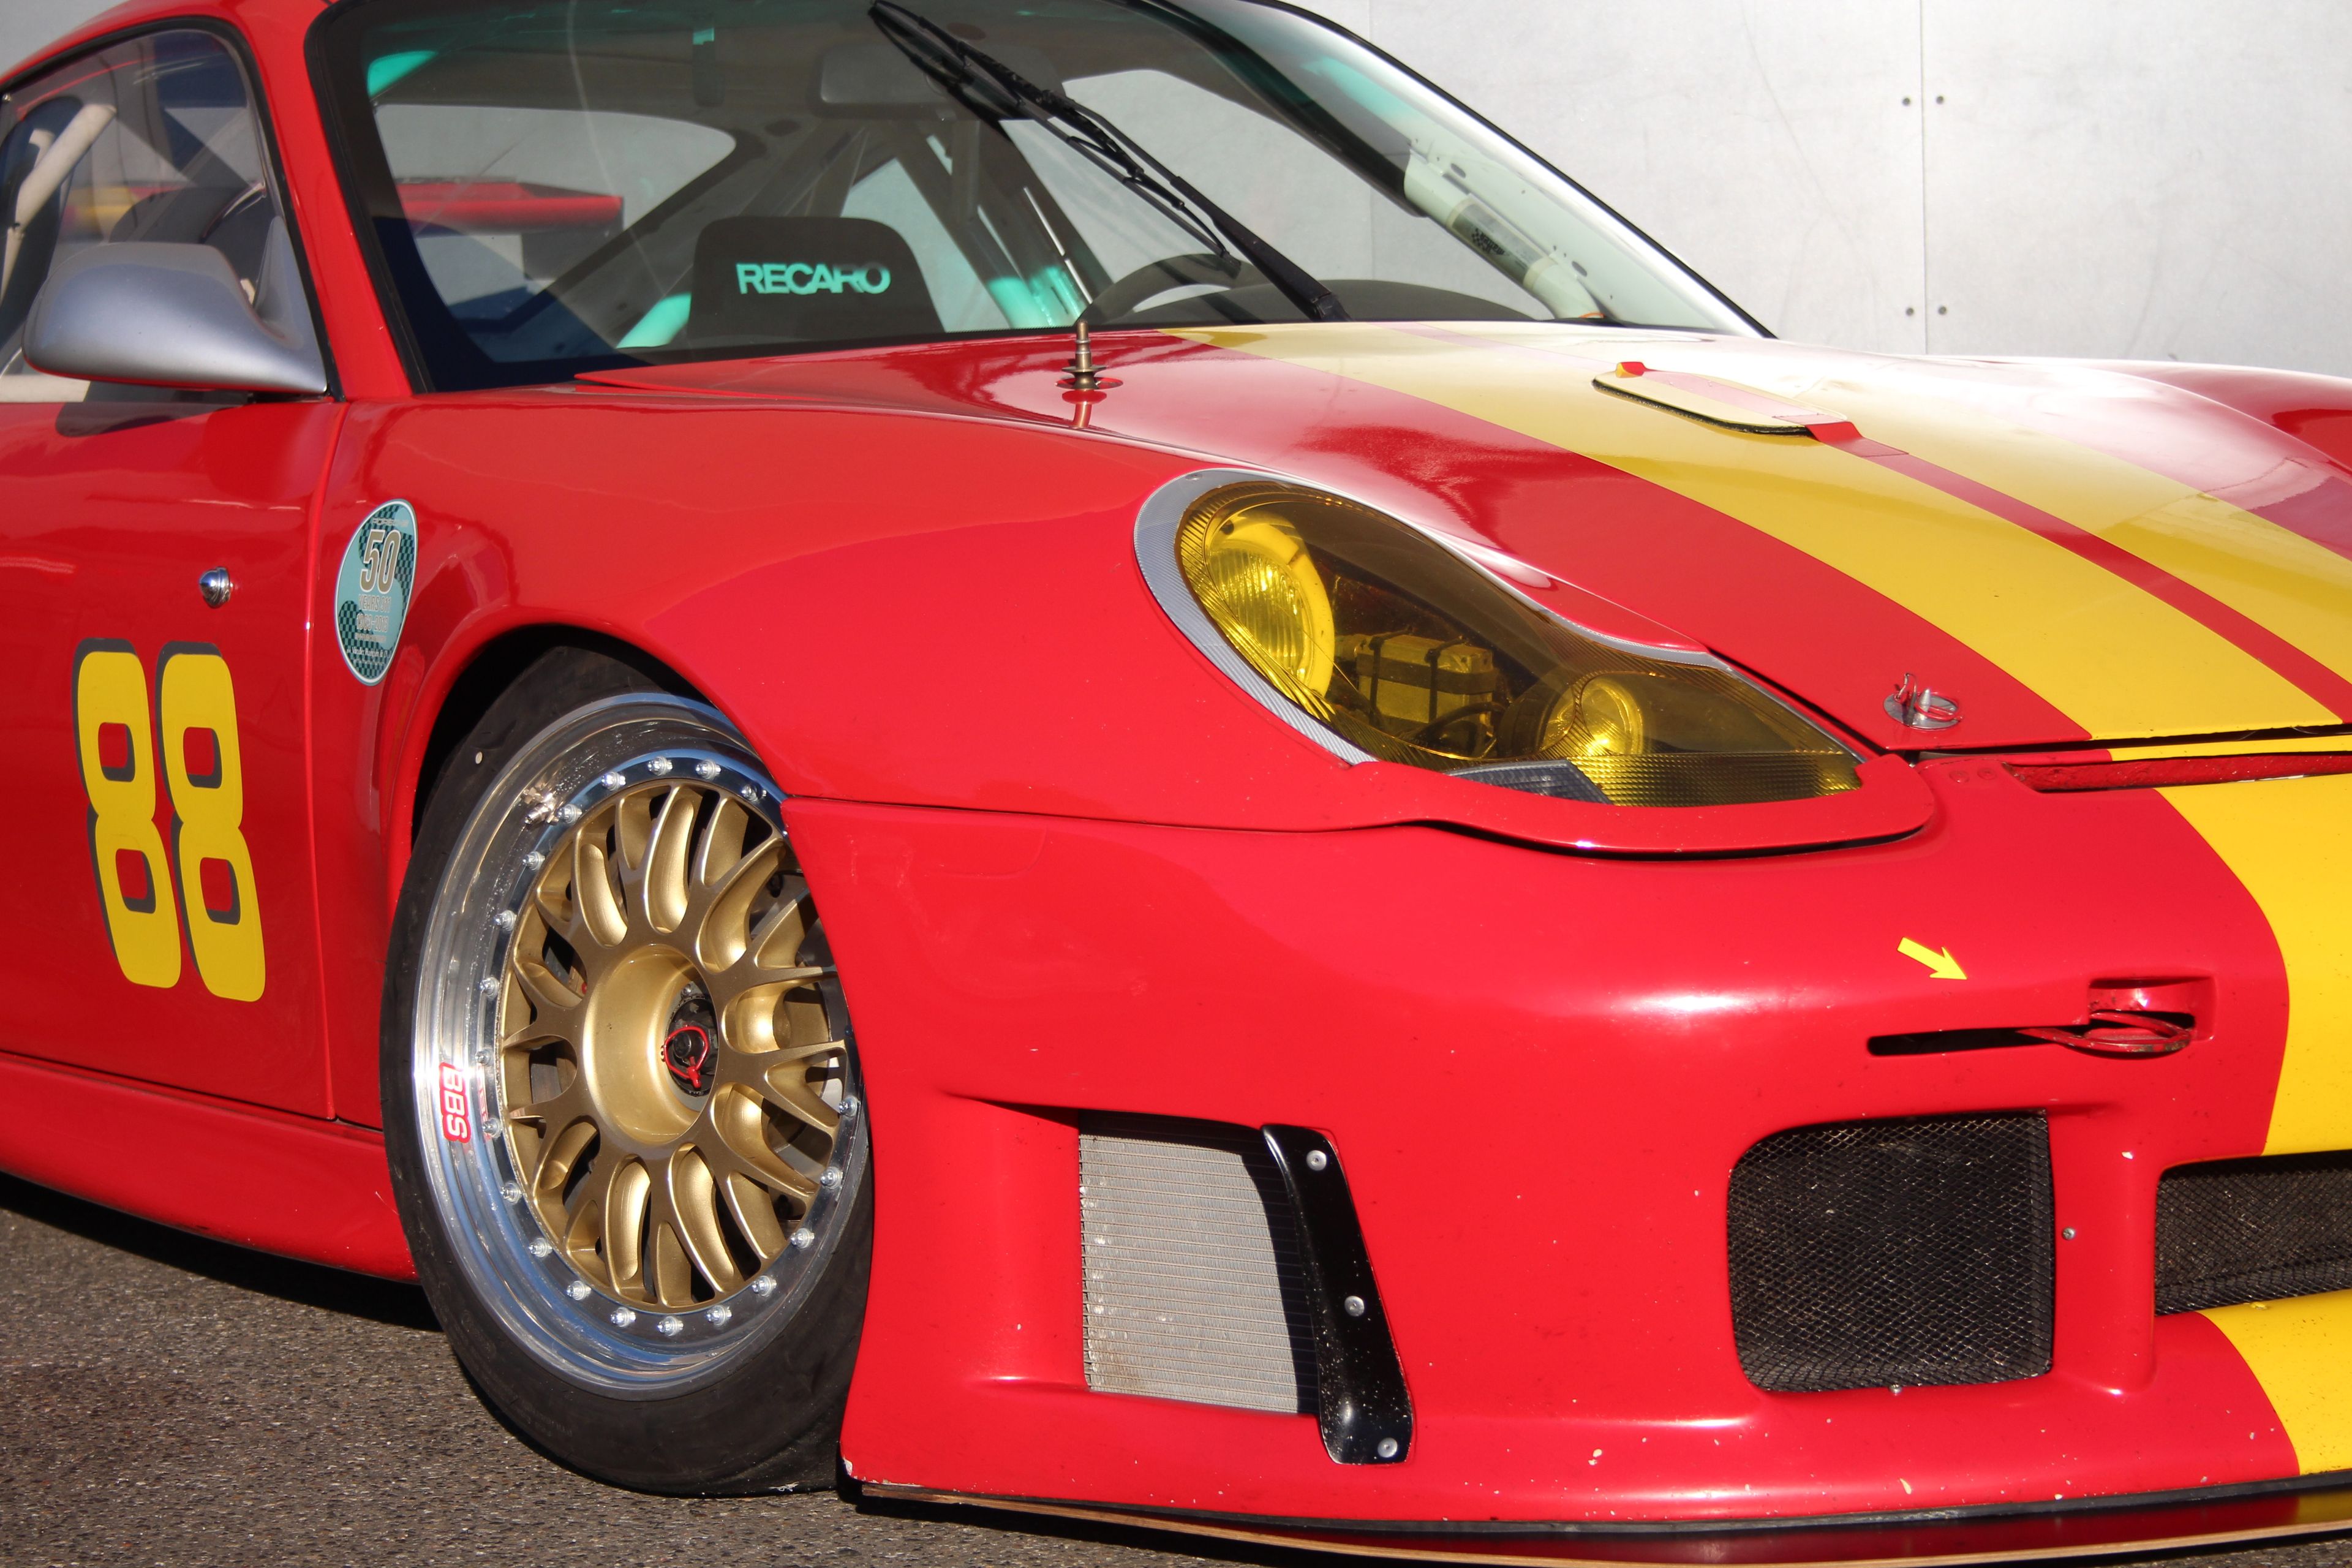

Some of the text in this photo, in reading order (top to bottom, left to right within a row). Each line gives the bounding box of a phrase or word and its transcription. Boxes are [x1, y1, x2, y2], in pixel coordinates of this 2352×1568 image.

[736, 262, 892, 295] RECARO
[360, 529, 401, 594] 50
[359, 594, 380, 611] YEARS
[72, 638, 266, 1002] 88
[440, 1064, 469, 1141] BBS
